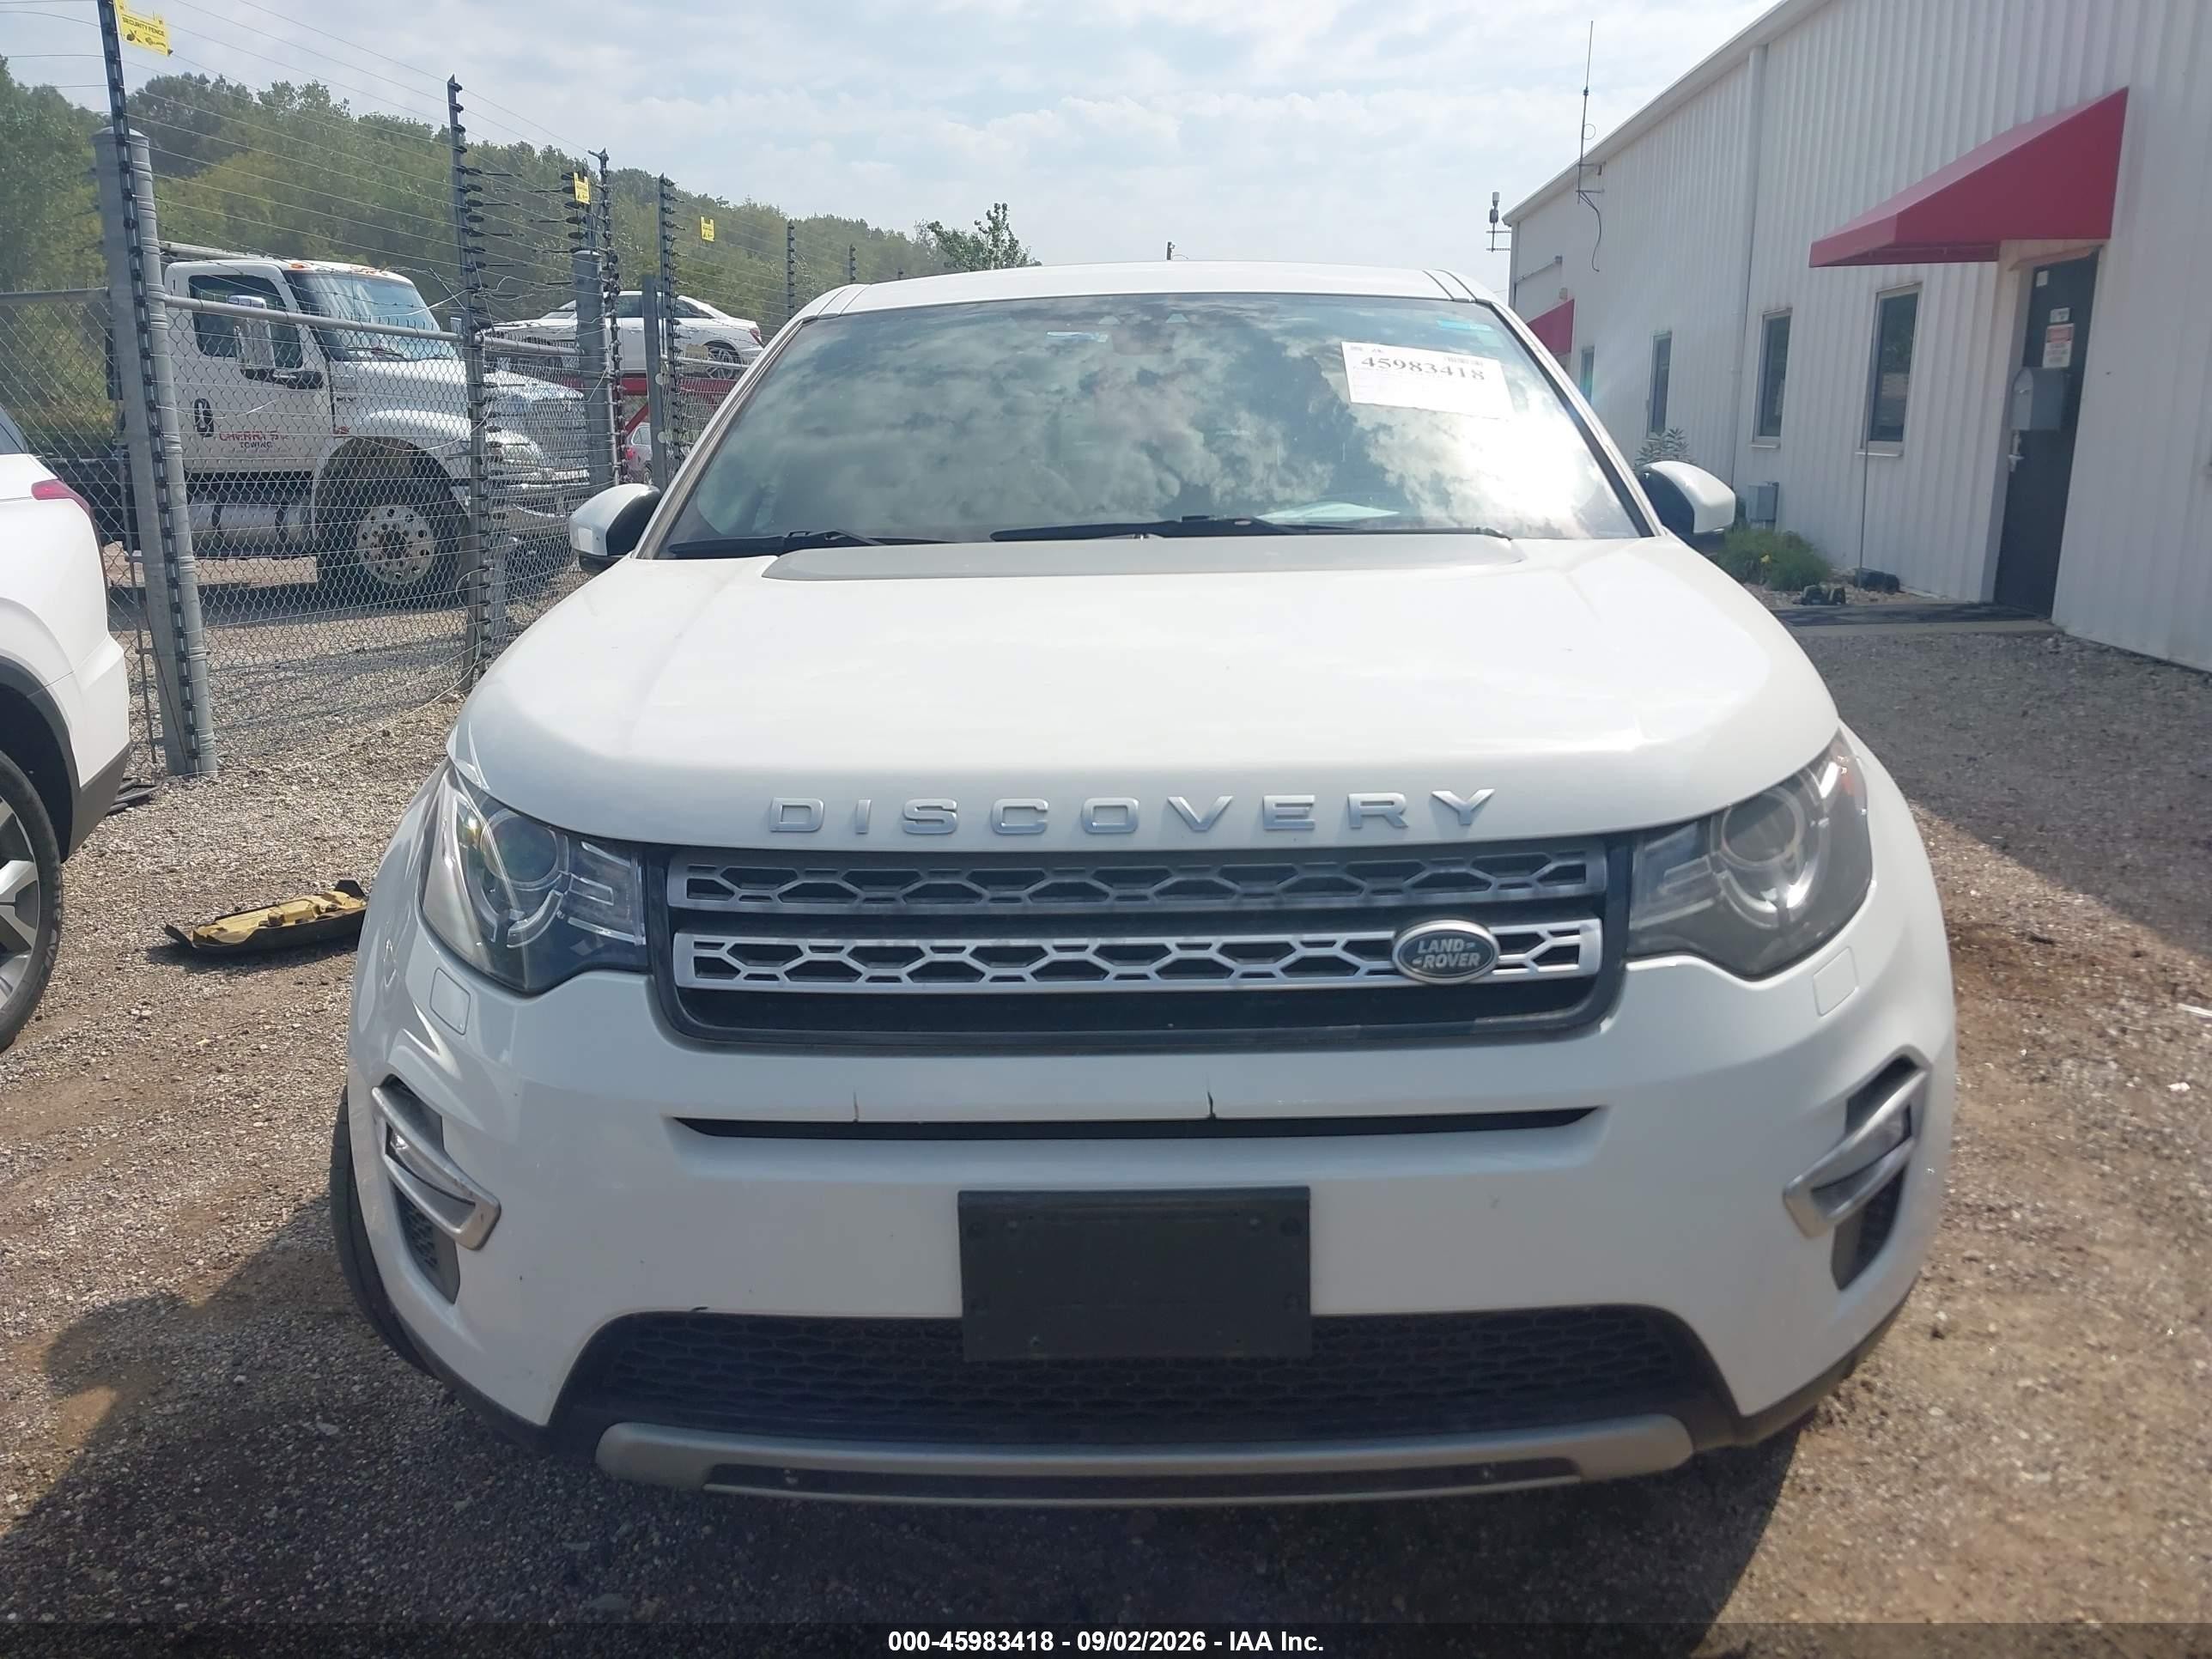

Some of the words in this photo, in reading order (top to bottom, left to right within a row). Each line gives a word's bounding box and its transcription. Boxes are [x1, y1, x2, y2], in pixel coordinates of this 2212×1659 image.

[122, 16, 148, 31] SECURITY
[148, 26, 166, 37] FENCE
[1361, 356, 1485, 380] 45983418
[769, 787, 1496, 835] DISCOVERY
[1418, 938, 1465, 954] LAND
[1422, 952, 1481, 969] ROVER
